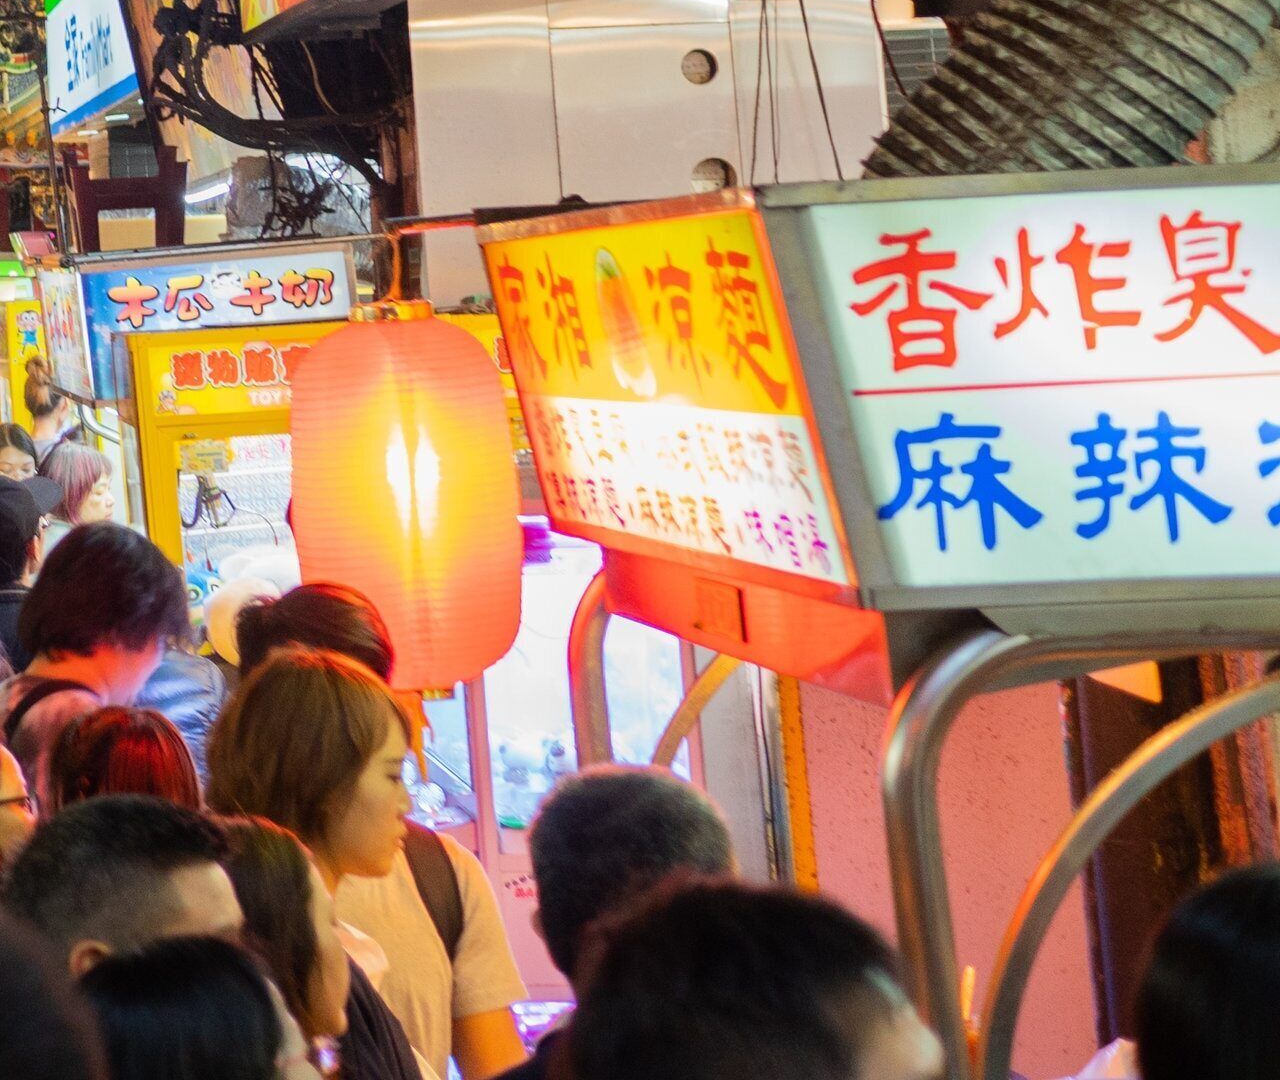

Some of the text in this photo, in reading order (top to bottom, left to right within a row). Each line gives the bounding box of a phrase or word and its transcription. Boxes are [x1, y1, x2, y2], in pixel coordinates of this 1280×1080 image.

[107, 266, 336, 329] 木瓜牛奶
[878, 411, 1280, 552] 麻辣
